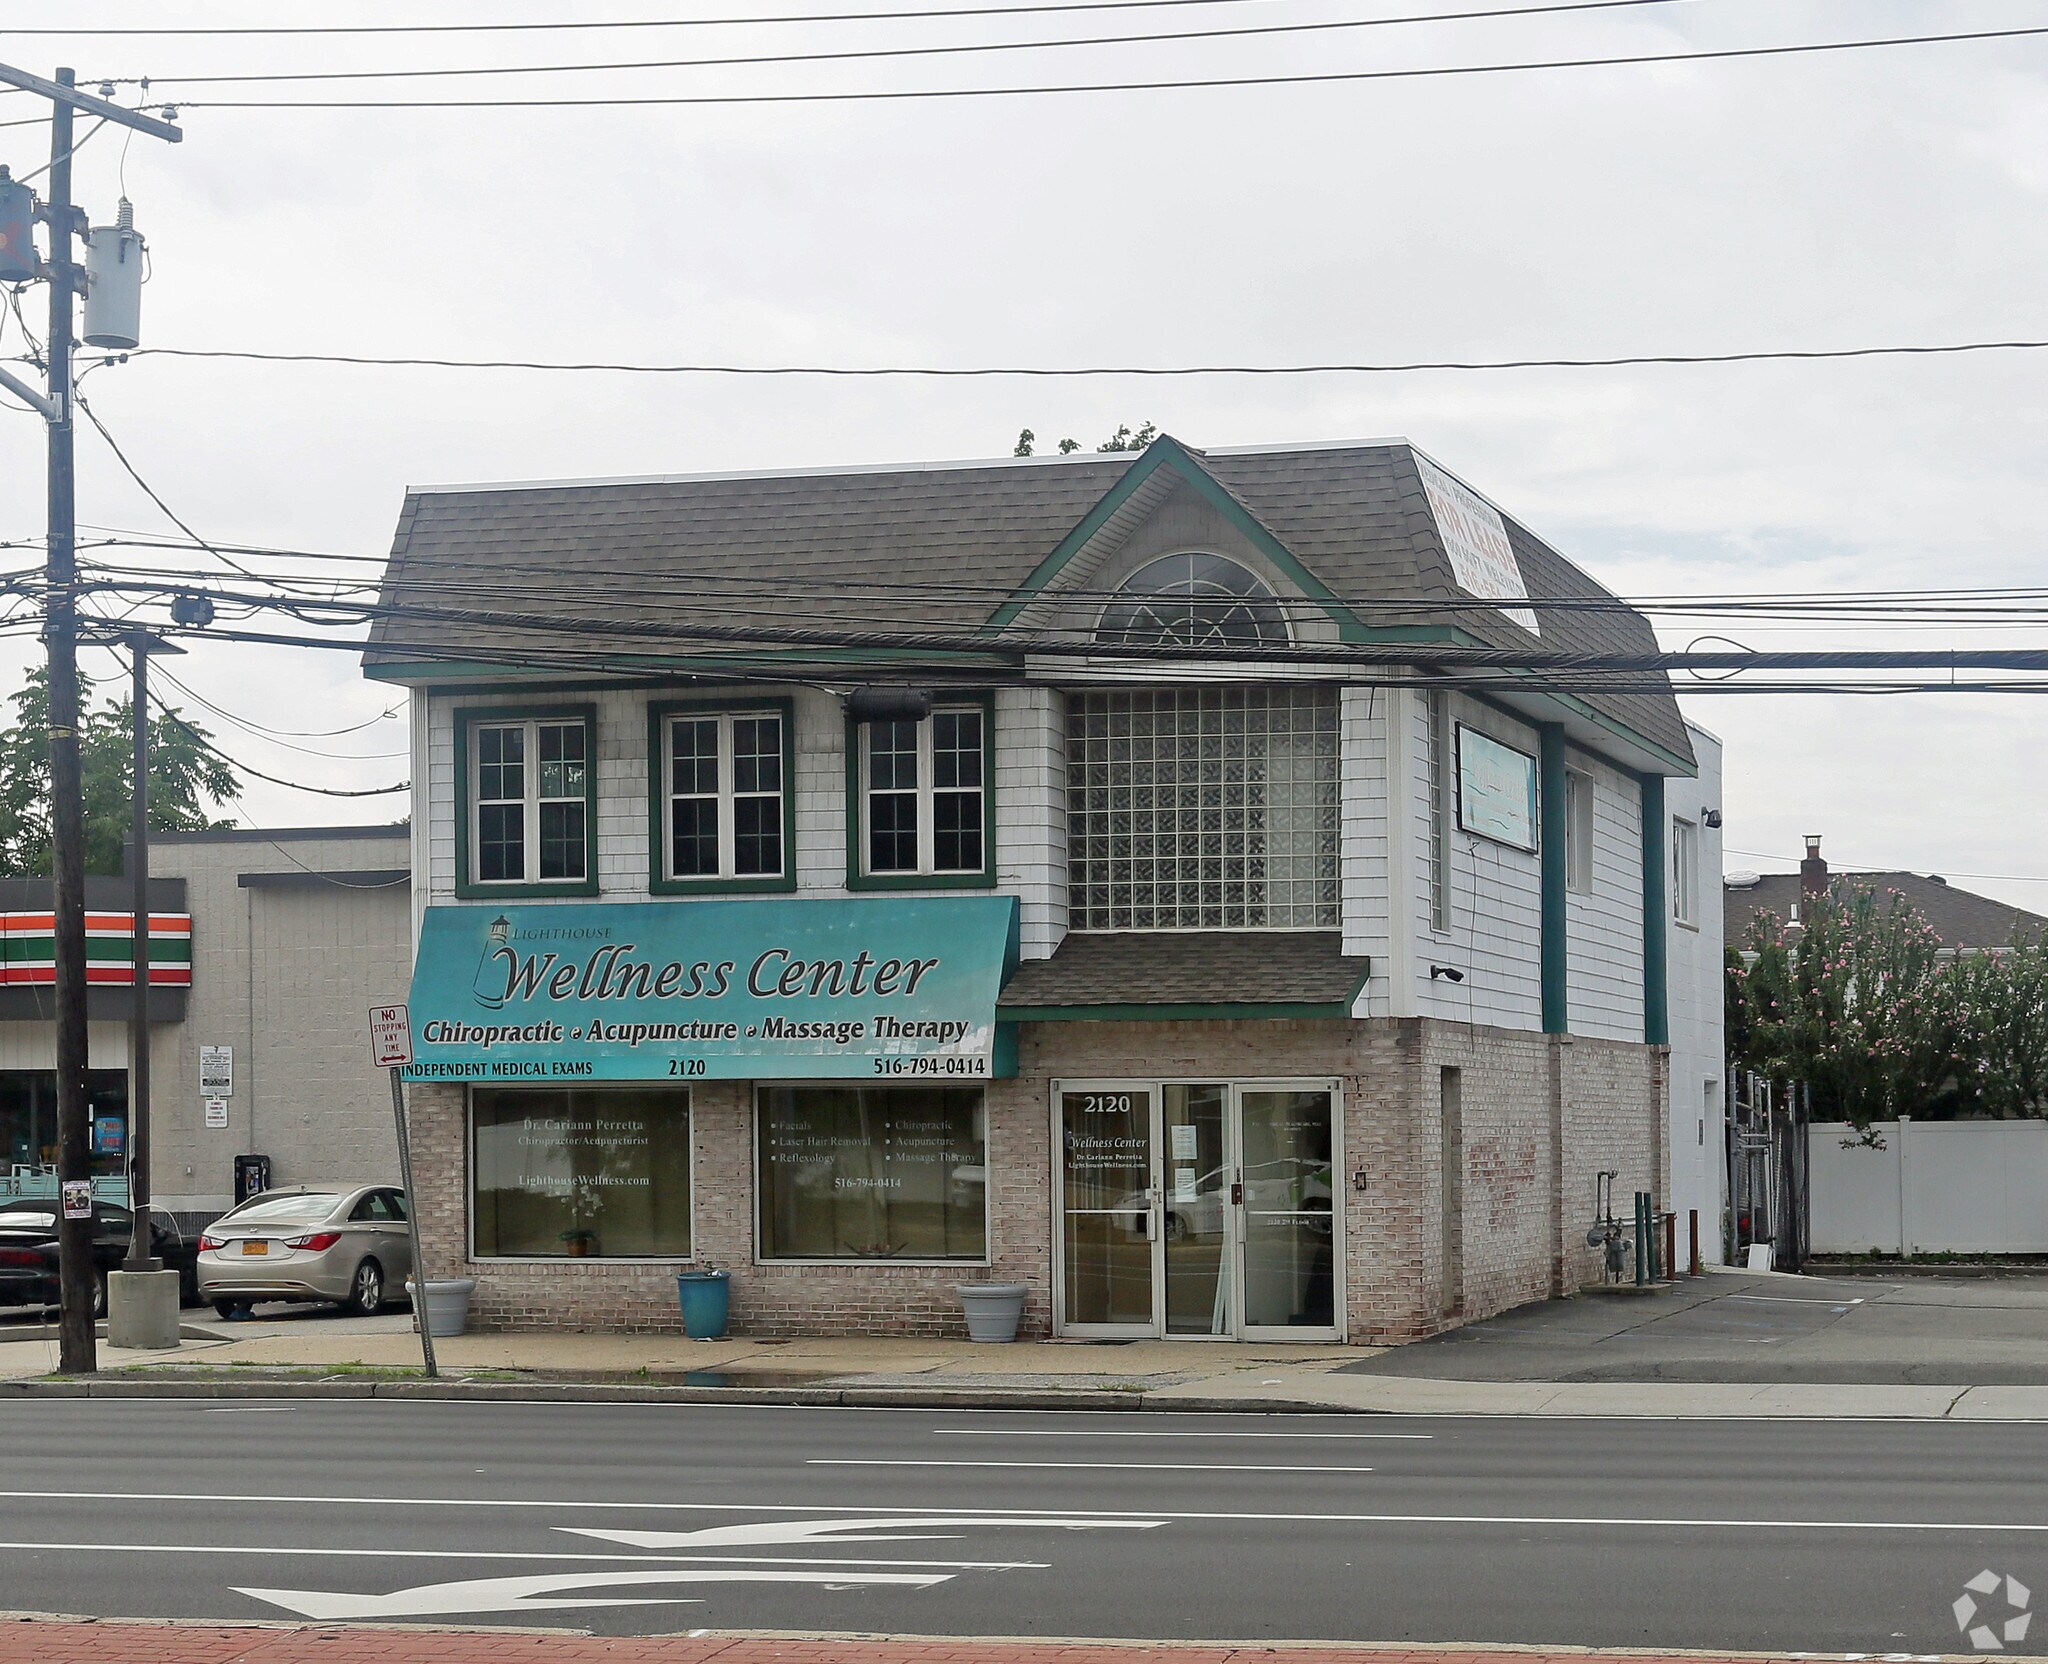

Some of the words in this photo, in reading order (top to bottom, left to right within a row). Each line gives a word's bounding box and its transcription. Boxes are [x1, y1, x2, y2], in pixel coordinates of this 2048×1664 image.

[1425, 485, 1469, 544] FOR
[1461, 510, 1519, 578] LEASE
[513, 927, 612, 940] LIGHTHOUSE
[492, 943, 735, 1002] Wellness
[746, 948, 938, 999] Center
[381, 1009, 396, 1021] NO
[374, 1022, 407, 1033] STOPPING
[422, 1020, 562, 1048] Chiropractic
[586, 1018, 737, 1046] Acupuncture
[761, 1017, 864, 1043] Massage
[874, 1016, 969, 1044] Therapy
[384, 1033, 398, 1042] ANY
[385, 1044, 400, 1052] TIME
[401, 1061, 487, 1077] INDEPENDENT
[491, 1061, 548, 1076] MEDICAL
[551, 1061, 593, 1076] EXAMS
[668, 1060, 706, 1076] 2120
[873, 1058, 985, 1076] 516-794-0414
[1084, 1095, 1131, 1113] 2120
[523, 1119, 541, 1131] Dr.
[544, 1119, 592, 1130] Cariann
[596, 1119, 644, 1130] Perretta
[779, 1120, 812, 1131] Facials
[895, 1120, 953, 1132] Chiropractic
[779, 1136, 805, 1146] Laser
[807, 1136, 827, 1146] Hair
[830, 1136, 871, 1146] Removal
[896, 1136, 955, 1148] Acupuncture
[1071, 1136, 1113, 1148] Wellness
[1114, 1137, 1147, 1148] Center
[779, 1153, 836, 1165] Reflexology
[896, 1153, 936, 1164] Massage
[939, 1152, 977, 1164] Therapy
[519, 1174, 650, 1188] LighthouseWellness.com
[834, 1178, 902, 1189] 516-794-0414
